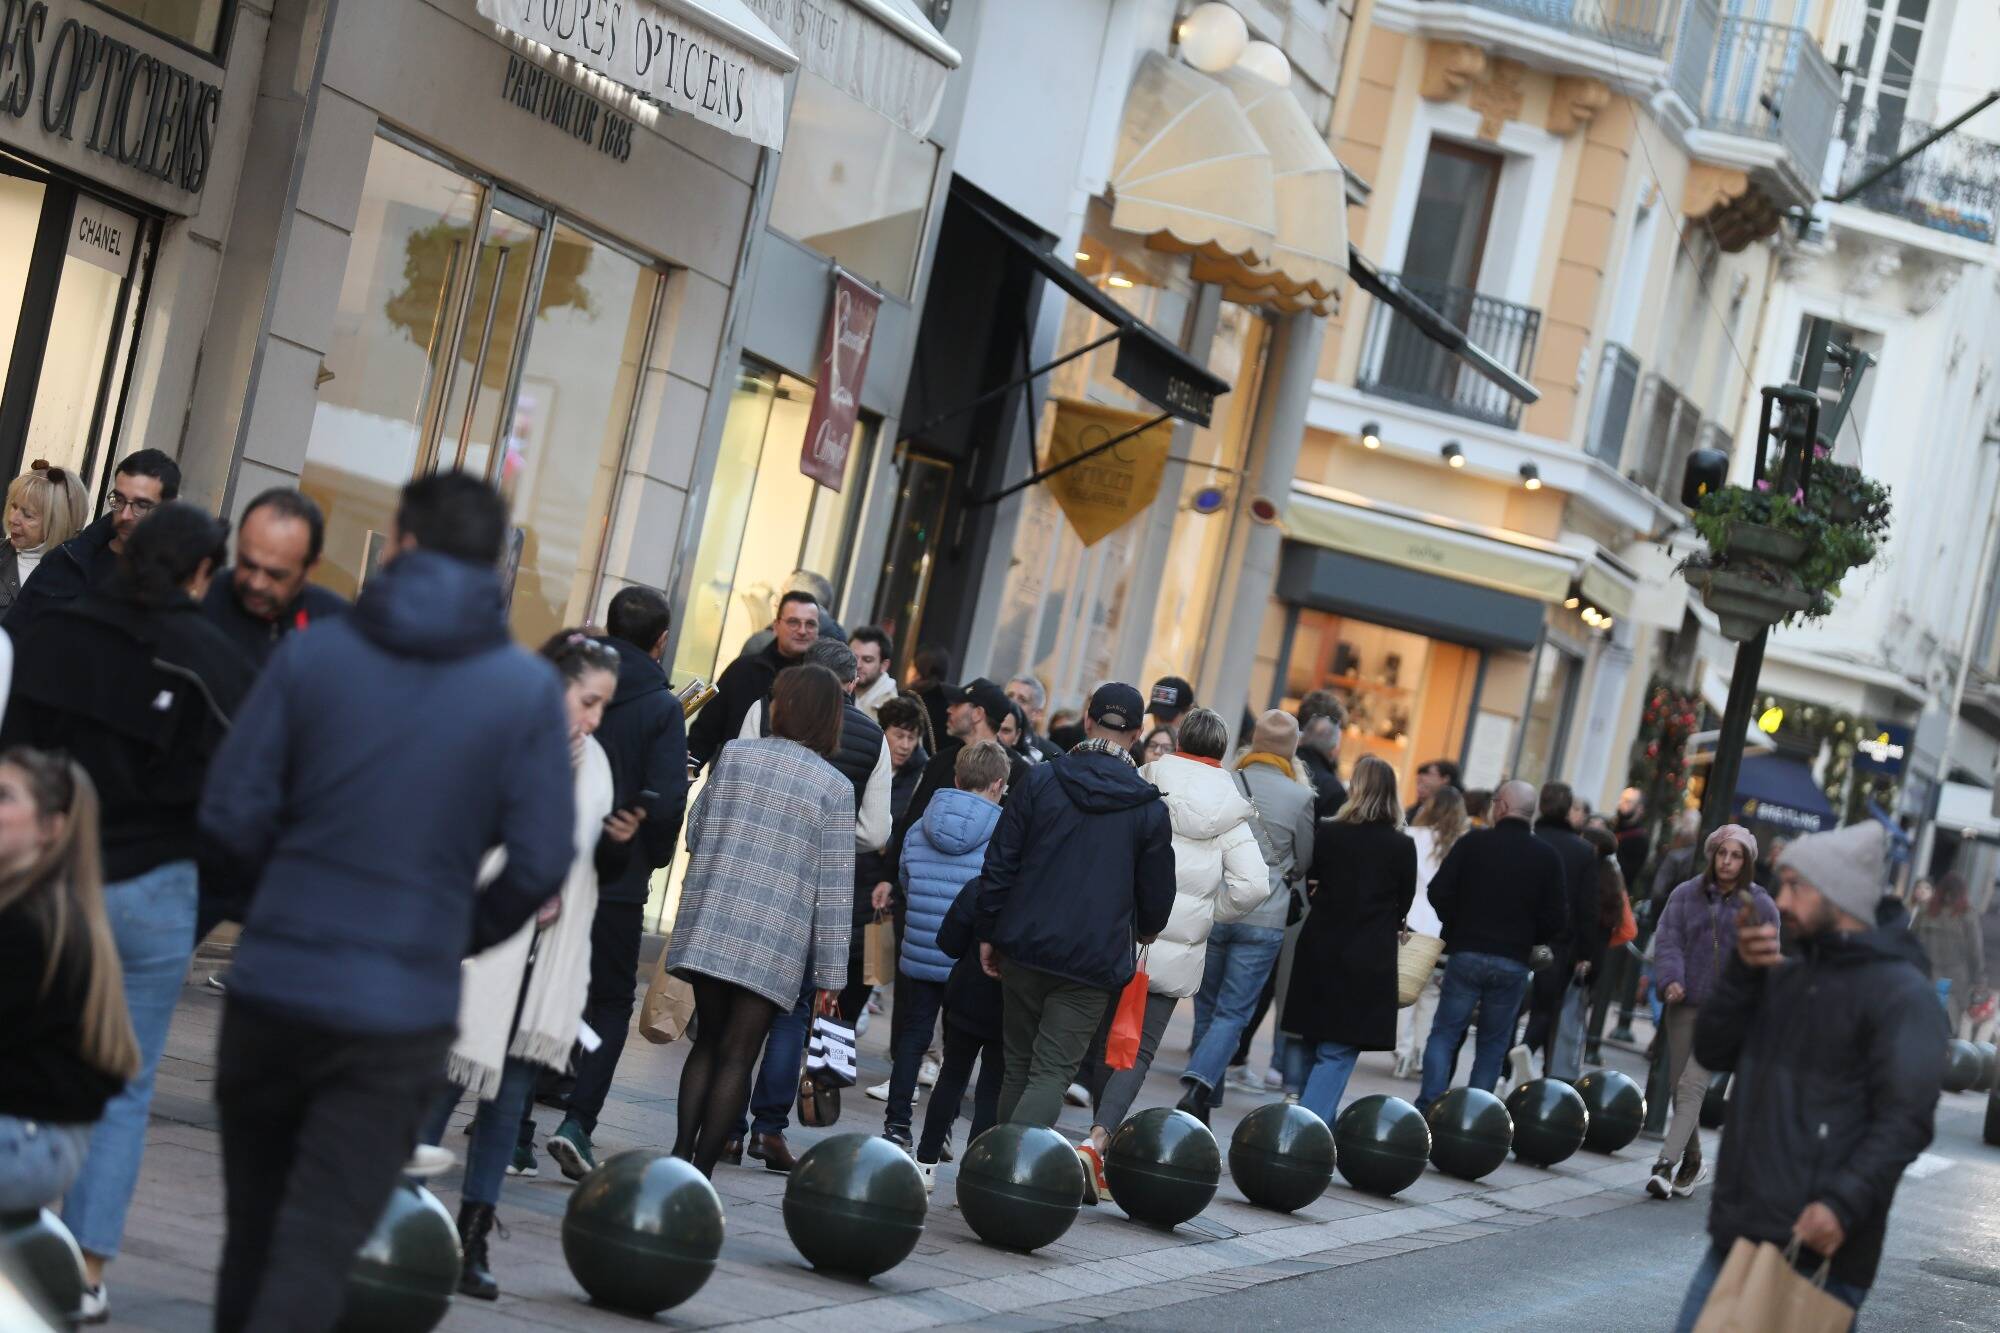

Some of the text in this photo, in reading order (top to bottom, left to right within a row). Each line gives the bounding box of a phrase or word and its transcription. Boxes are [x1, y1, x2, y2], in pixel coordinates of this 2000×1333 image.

[42, 18, 223, 194] OPTICIENS
[598, 109, 635, 164] 1885
[79, 216, 122, 256] CHANEL
[1757, 802, 1820, 832] BREITLING
